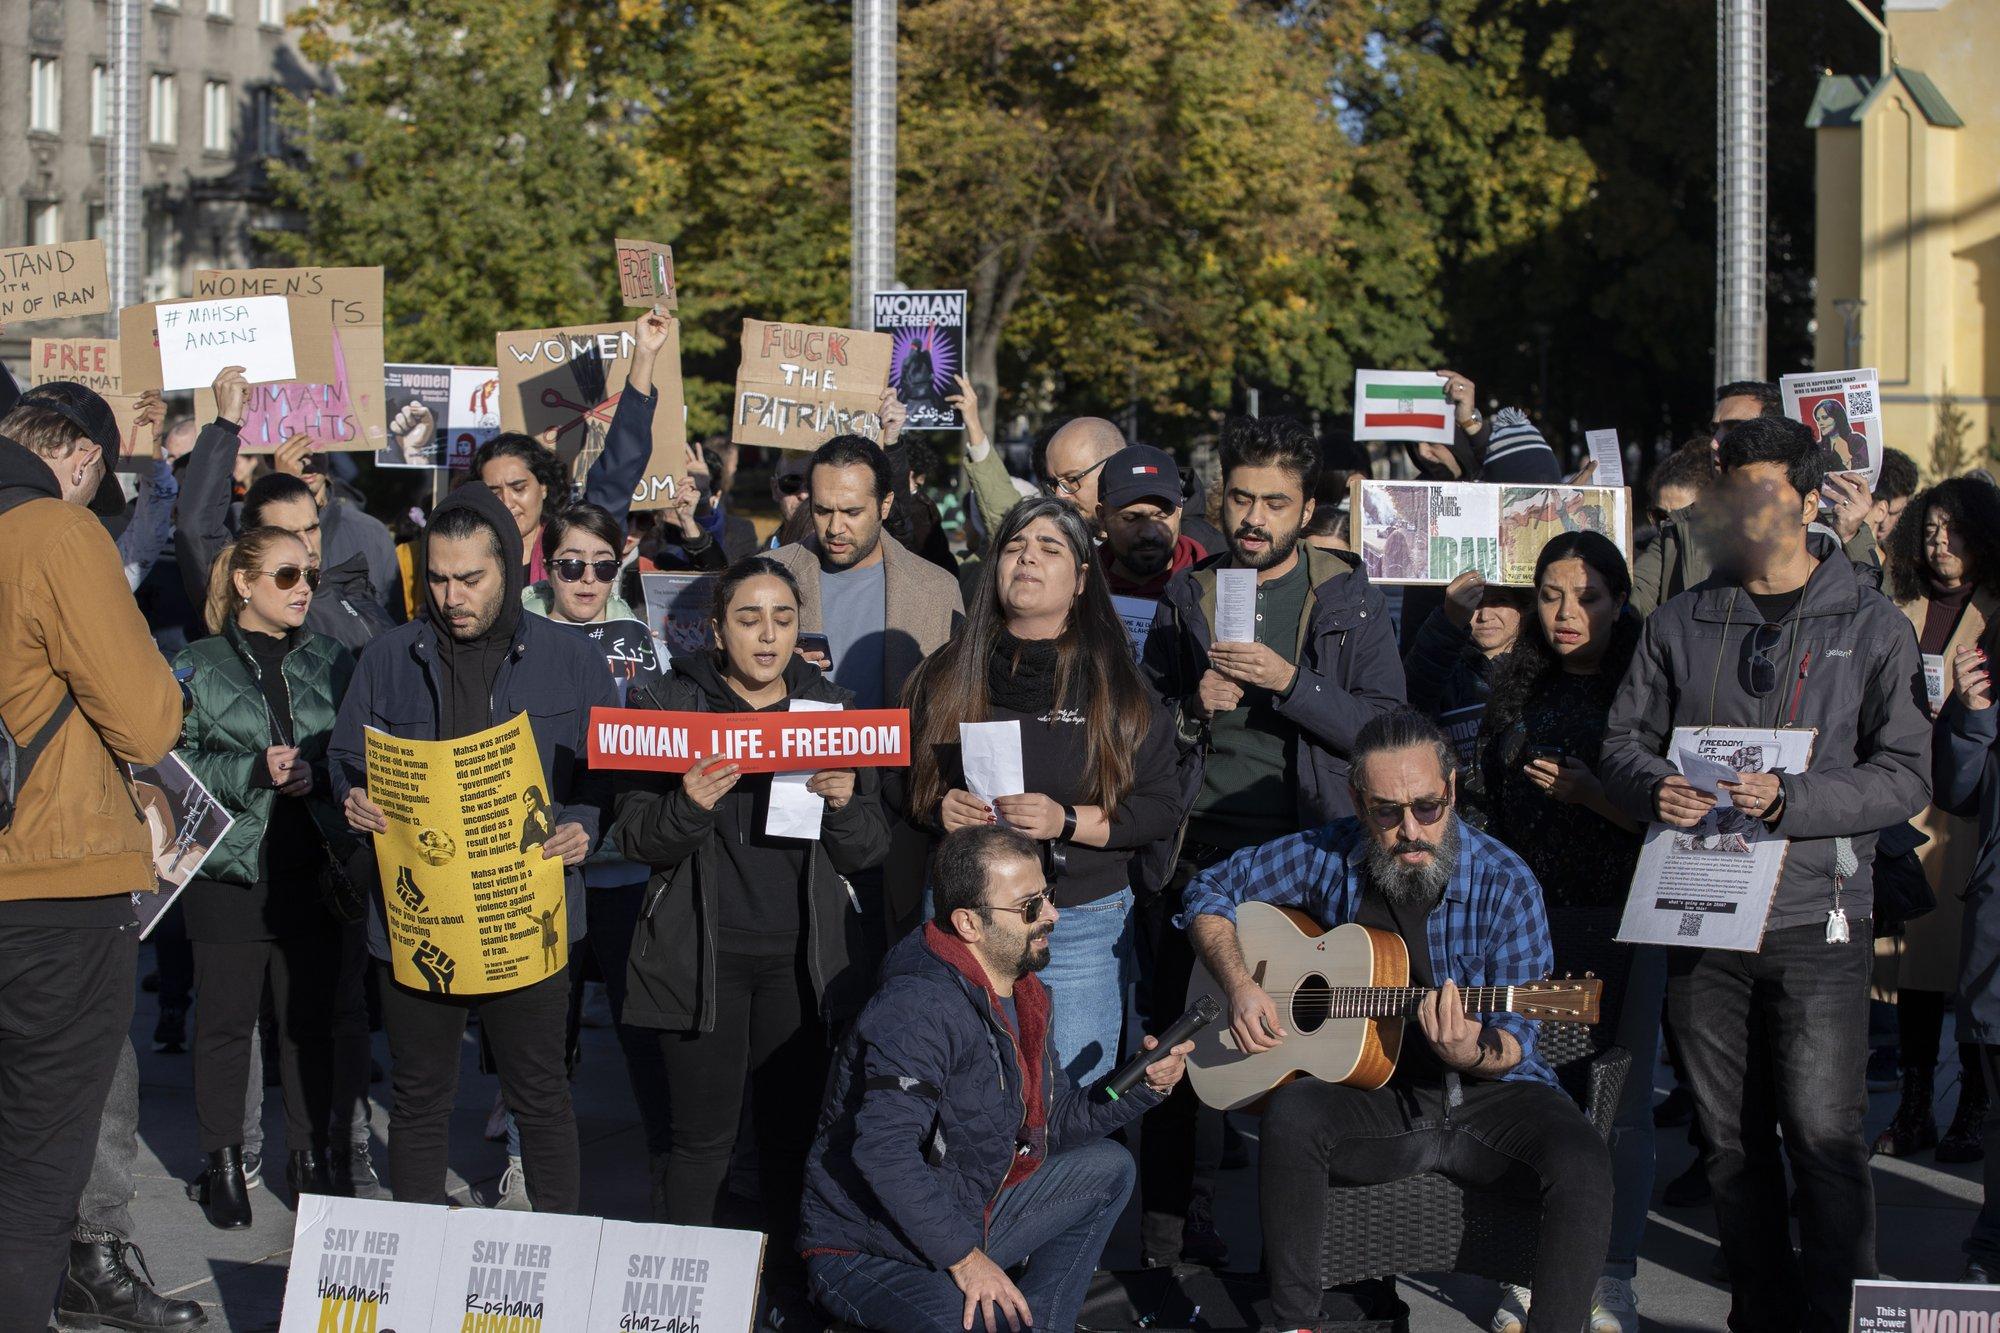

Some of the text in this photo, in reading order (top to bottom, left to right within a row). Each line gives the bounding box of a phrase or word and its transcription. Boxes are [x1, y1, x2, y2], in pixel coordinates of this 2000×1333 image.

[200, 272, 323, 296] WOMEN'S
[23, 298, 43, 314] OF
[53, 286, 94, 308] IRAN
[875, 296, 962, 315] WOMAN
[188, 305, 249, 324] MAHSA
[185, 328, 257, 350] AMINI
[761, 324, 849, 366] FUCK
[43, 343, 106, 372] FREE
[402, 373, 449, 388] women
[779, 363, 837, 391] THE
[1430, 486, 1442, 497] THE
[453, 727, 521, 756] Mahsa was arrested
[598, 722, 689, 759] WOMAN
[782, 726, 900, 758] FREEDOM
[401, 748, 414, 756] was
[455, 742, 516, 768] because her hijab
[404, 760, 429, 769] woman
[456, 756, 513, 779] did not meet the
[385, 778, 410, 790] arrested
[411, 783, 419, 792] by
[410, 772, 427, 780] after
[401, 793, 430, 804] Republic
[461, 792, 517, 814] She was beaten
[463, 808, 510, 825] unconscious
[465, 818, 513, 836] and died as a
[466, 831, 511, 848] result of her
[468, 842, 518, 859] brain injuries.
[471, 860, 526, 879] Mahsa was the
[472, 879, 495, 890] latest
[495, 873, 519, 886] victim
[520, 870, 527, 879] in
[474, 882, 527, 902] long history of
[476, 892, 535, 912] violence against
[403, 911, 416, 922] you
[417, 915, 439, 925] heard
[440, 914, 464, 925] about
[477, 904, 532, 923] women carried
[400, 923, 431, 938] uprising
[479, 920, 517, 935] out by the
[480, 926, 540, 946] Islamic Republic
[398, 934, 416, 947] Iran?
[482, 946, 509, 957] of Iran.
[323, 1227, 400, 1256] SAY HER
[472, 1240, 552, 1269] SAY HER
[318, 1253, 395, 1290] NAME
[627, 1254, 710, 1283] SAY HER
[317, 1276, 389, 1305] Hananeh
[466, 1266, 547, 1303] NAME
[466, 1293, 544, 1319] Roshana
[621, 1280, 705, 1319] NAME
[317, 1297, 379, 1333] KIA
[619, 1310, 700, 1333] Ghazaleh
[1876, 1306, 1906, 1317] This is
[1860, 1317, 1906, 1328] the Power
